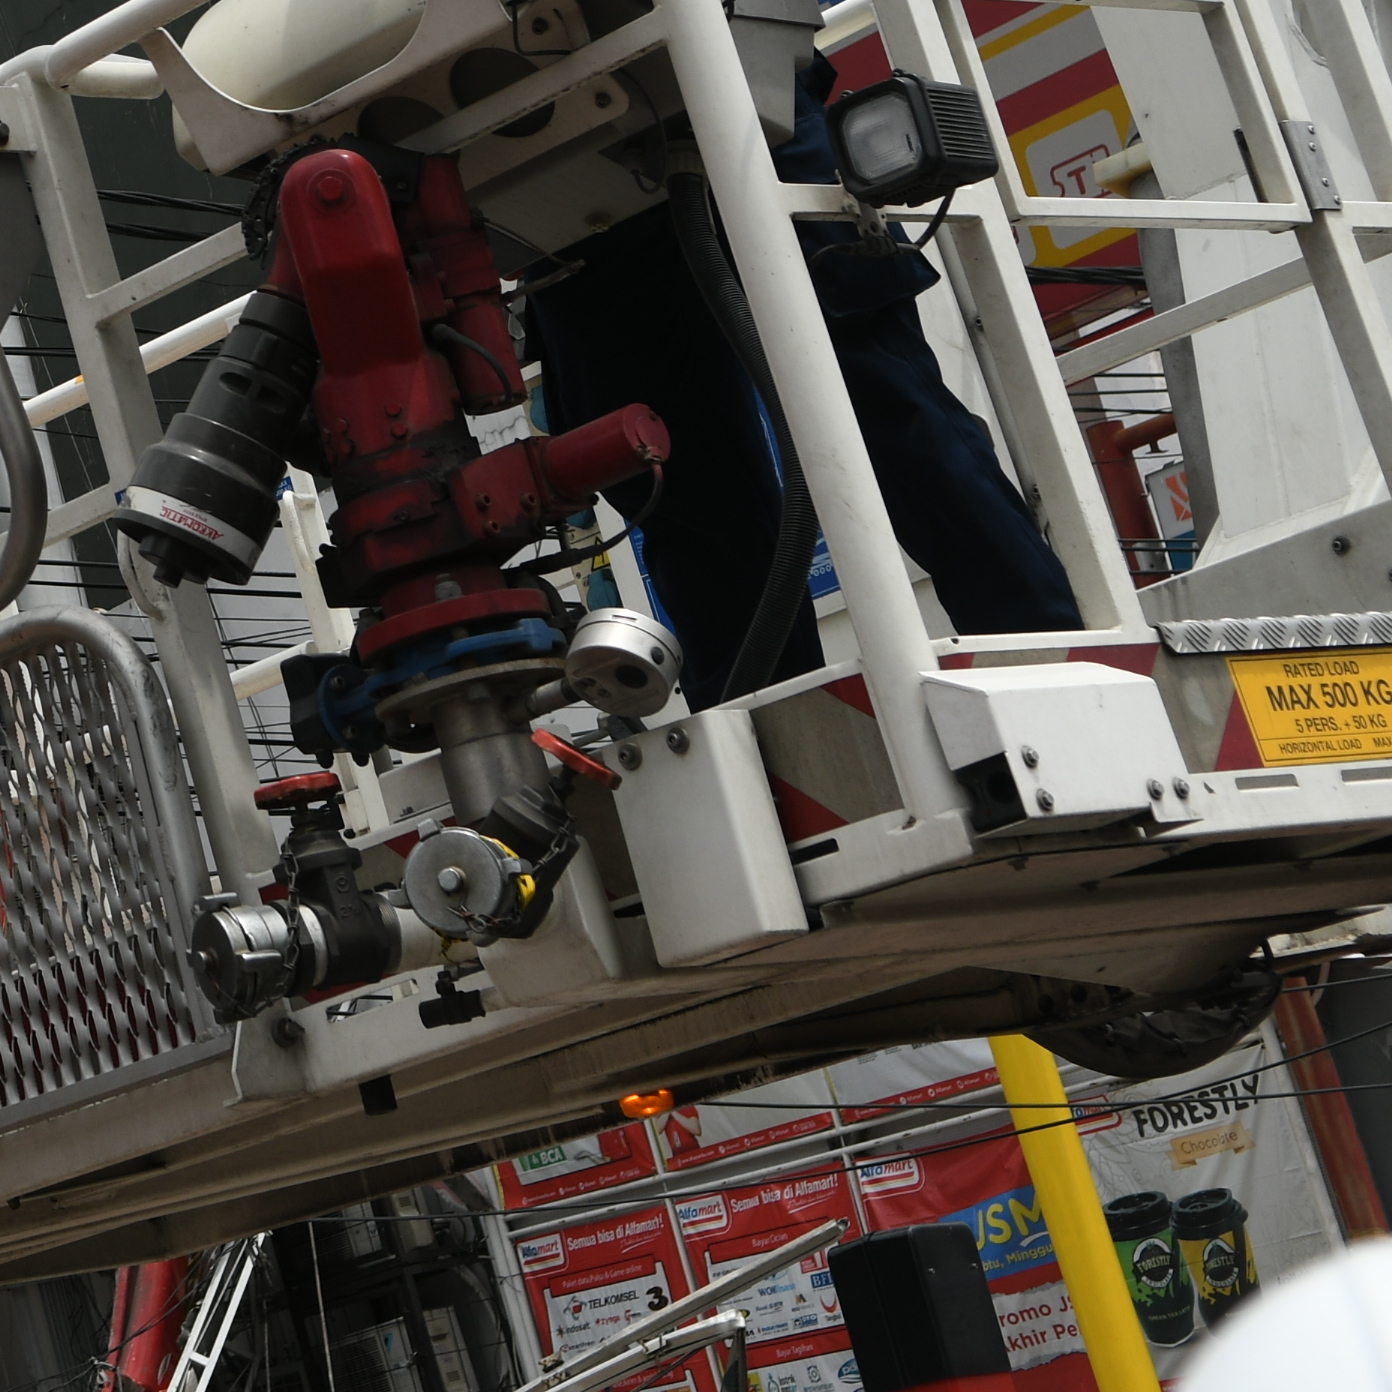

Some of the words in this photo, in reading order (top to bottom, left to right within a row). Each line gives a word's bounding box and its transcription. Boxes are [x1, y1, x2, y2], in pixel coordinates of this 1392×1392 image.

[1283, 663, 1324, 679] RATED
[1326, 660, 1360, 676] LOAD
[1266, 683, 1320, 712] MAX
[1321, 681, 1358, 709] 500
[1360, 678, 1392, 707] KG
[1295, 719, 1304, 733] 5
[1306, 716, 1342, 733] PERS.
[1352, 715, 1368, 730] 50
[1368, 713, 1387, 729] KG
[1279, 739, 1337, 754] HORIZONTAL
[1338, 738, 1363, 751] LOAD
[1133, 1074, 1260, 1137] FORESTLY
[1181, 1130, 1238, 1154] Chocolate
[540, 1148, 563, 1165] BCA
[731, 1195, 760, 1213] Semua
[762, 1188, 781, 1205] bisa
[783, 1185, 794, 1199] di
[795, 1173, 839, 1197] Alfamart!
[678, 1200, 722, 1220] Alfamart
[567, 1235, 597, 1251] Semua
[597, 1228, 615, 1245] bisa
[616, 1224, 624, 1238] di
[625, 1213, 664, 1237] Alfamart!
[522, 1239, 560, 1259] Alfamart
[1136, 1255, 1171, 1273] FORESTLY
[588, 1290, 640, 1309] TELKOMSEL
[999, 1303, 1052, 1328] romo
